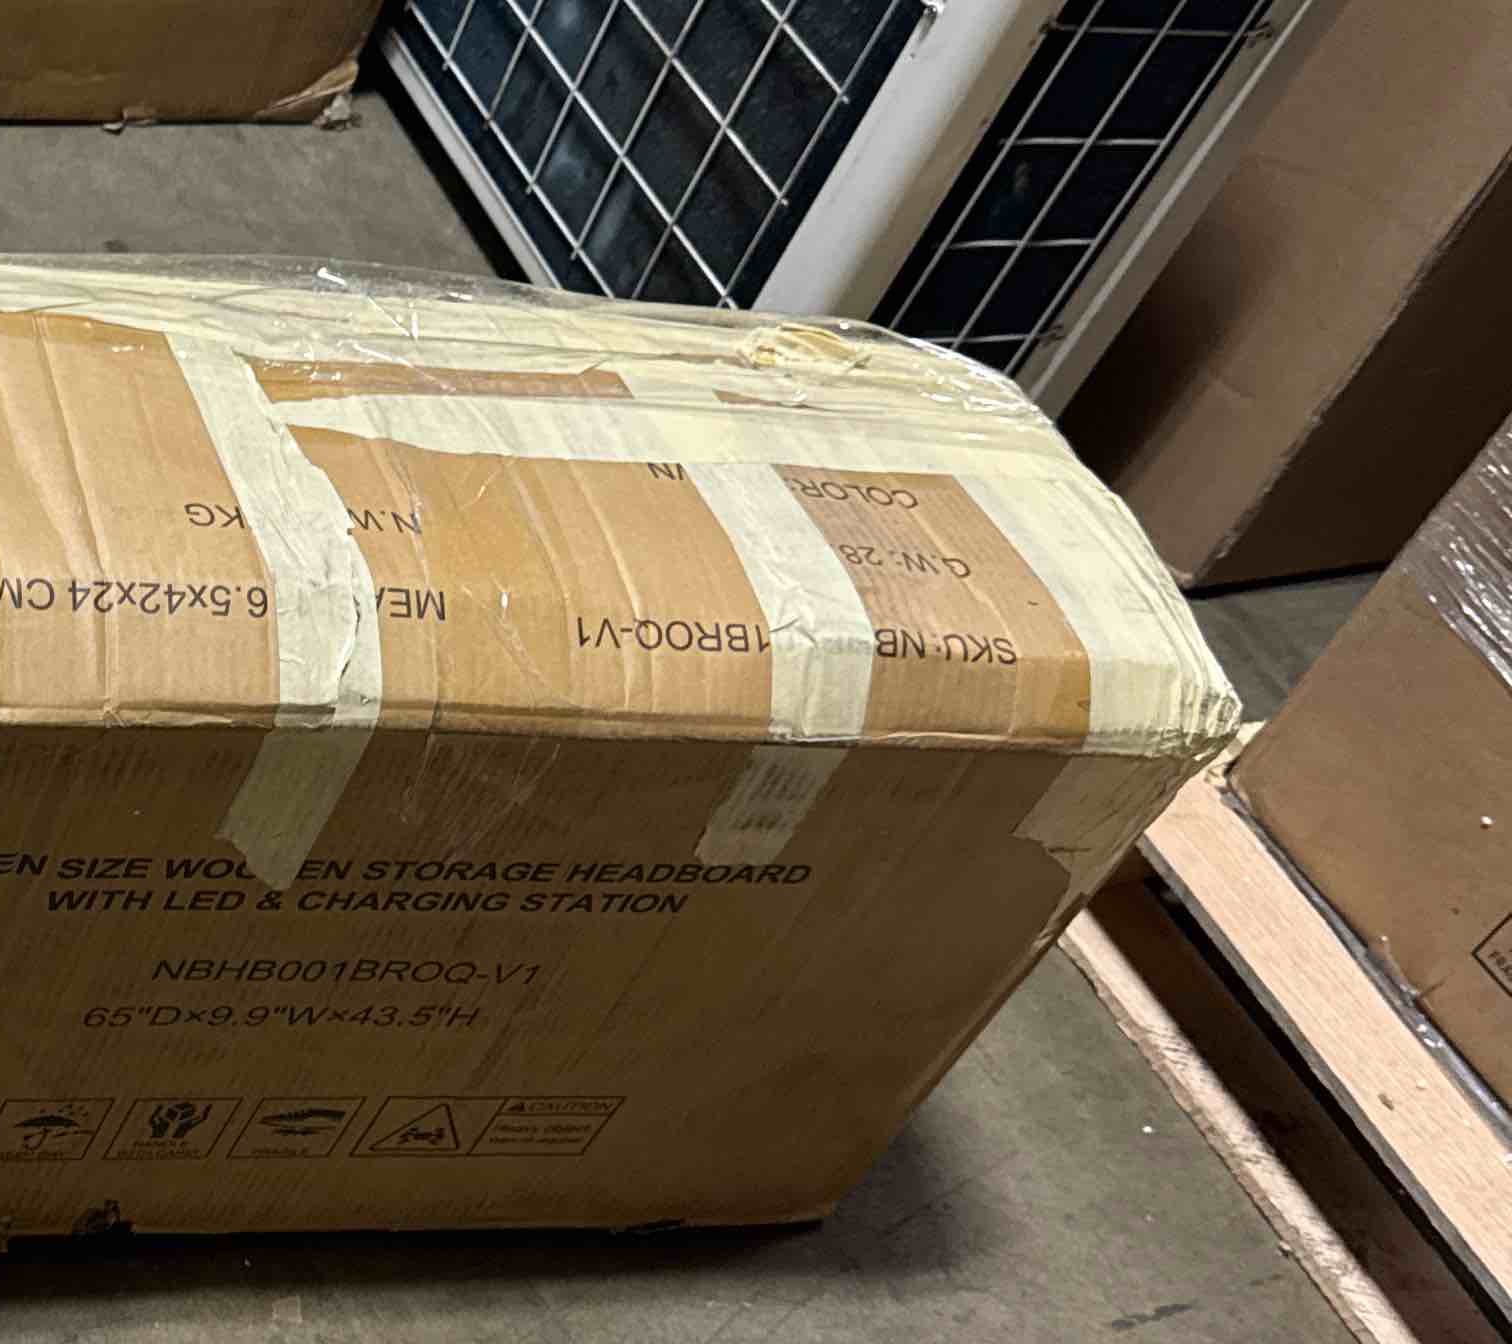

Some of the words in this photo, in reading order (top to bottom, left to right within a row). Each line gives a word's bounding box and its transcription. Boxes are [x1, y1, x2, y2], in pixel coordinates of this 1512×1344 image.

[183, 502, 249, 531] KG
[56, 856, 153, 881] SIZE
[362, 859, 561, 884] STORAGE
[565, 862, 813, 886] HEADBOARD
[46, 889, 154, 913] WITH
[161, 889, 247, 913] LED
[254, 889, 284, 913] &
[296, 889, 510, 913] CHARGING
[519, 890, 691, 914] STATION
[150, 958, 544, 986] NBHB001BROQ-V1
